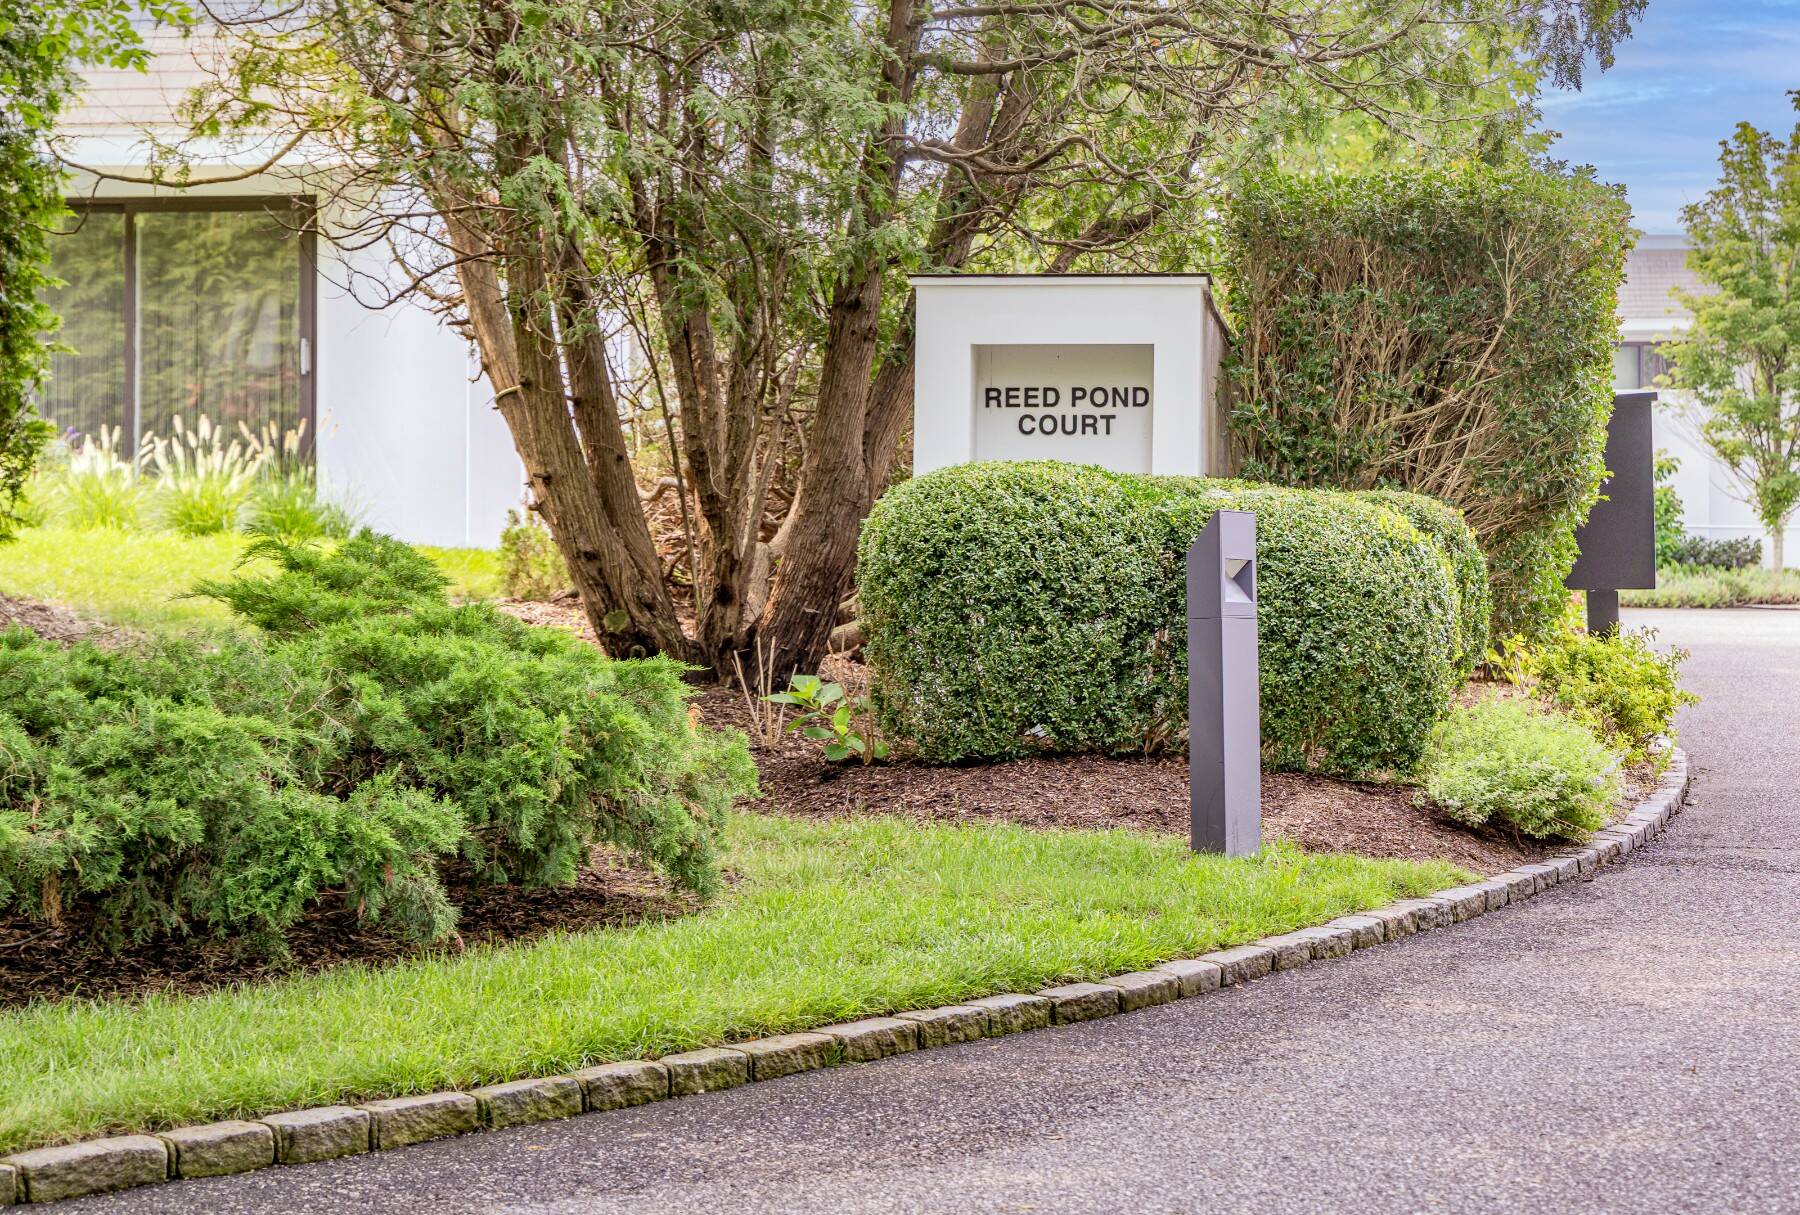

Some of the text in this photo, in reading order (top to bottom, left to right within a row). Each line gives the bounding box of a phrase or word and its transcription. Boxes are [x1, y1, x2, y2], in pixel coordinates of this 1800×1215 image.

[985, 386, 1150, 408] REED POND
[1018, 413, 1117, 436] COURT
